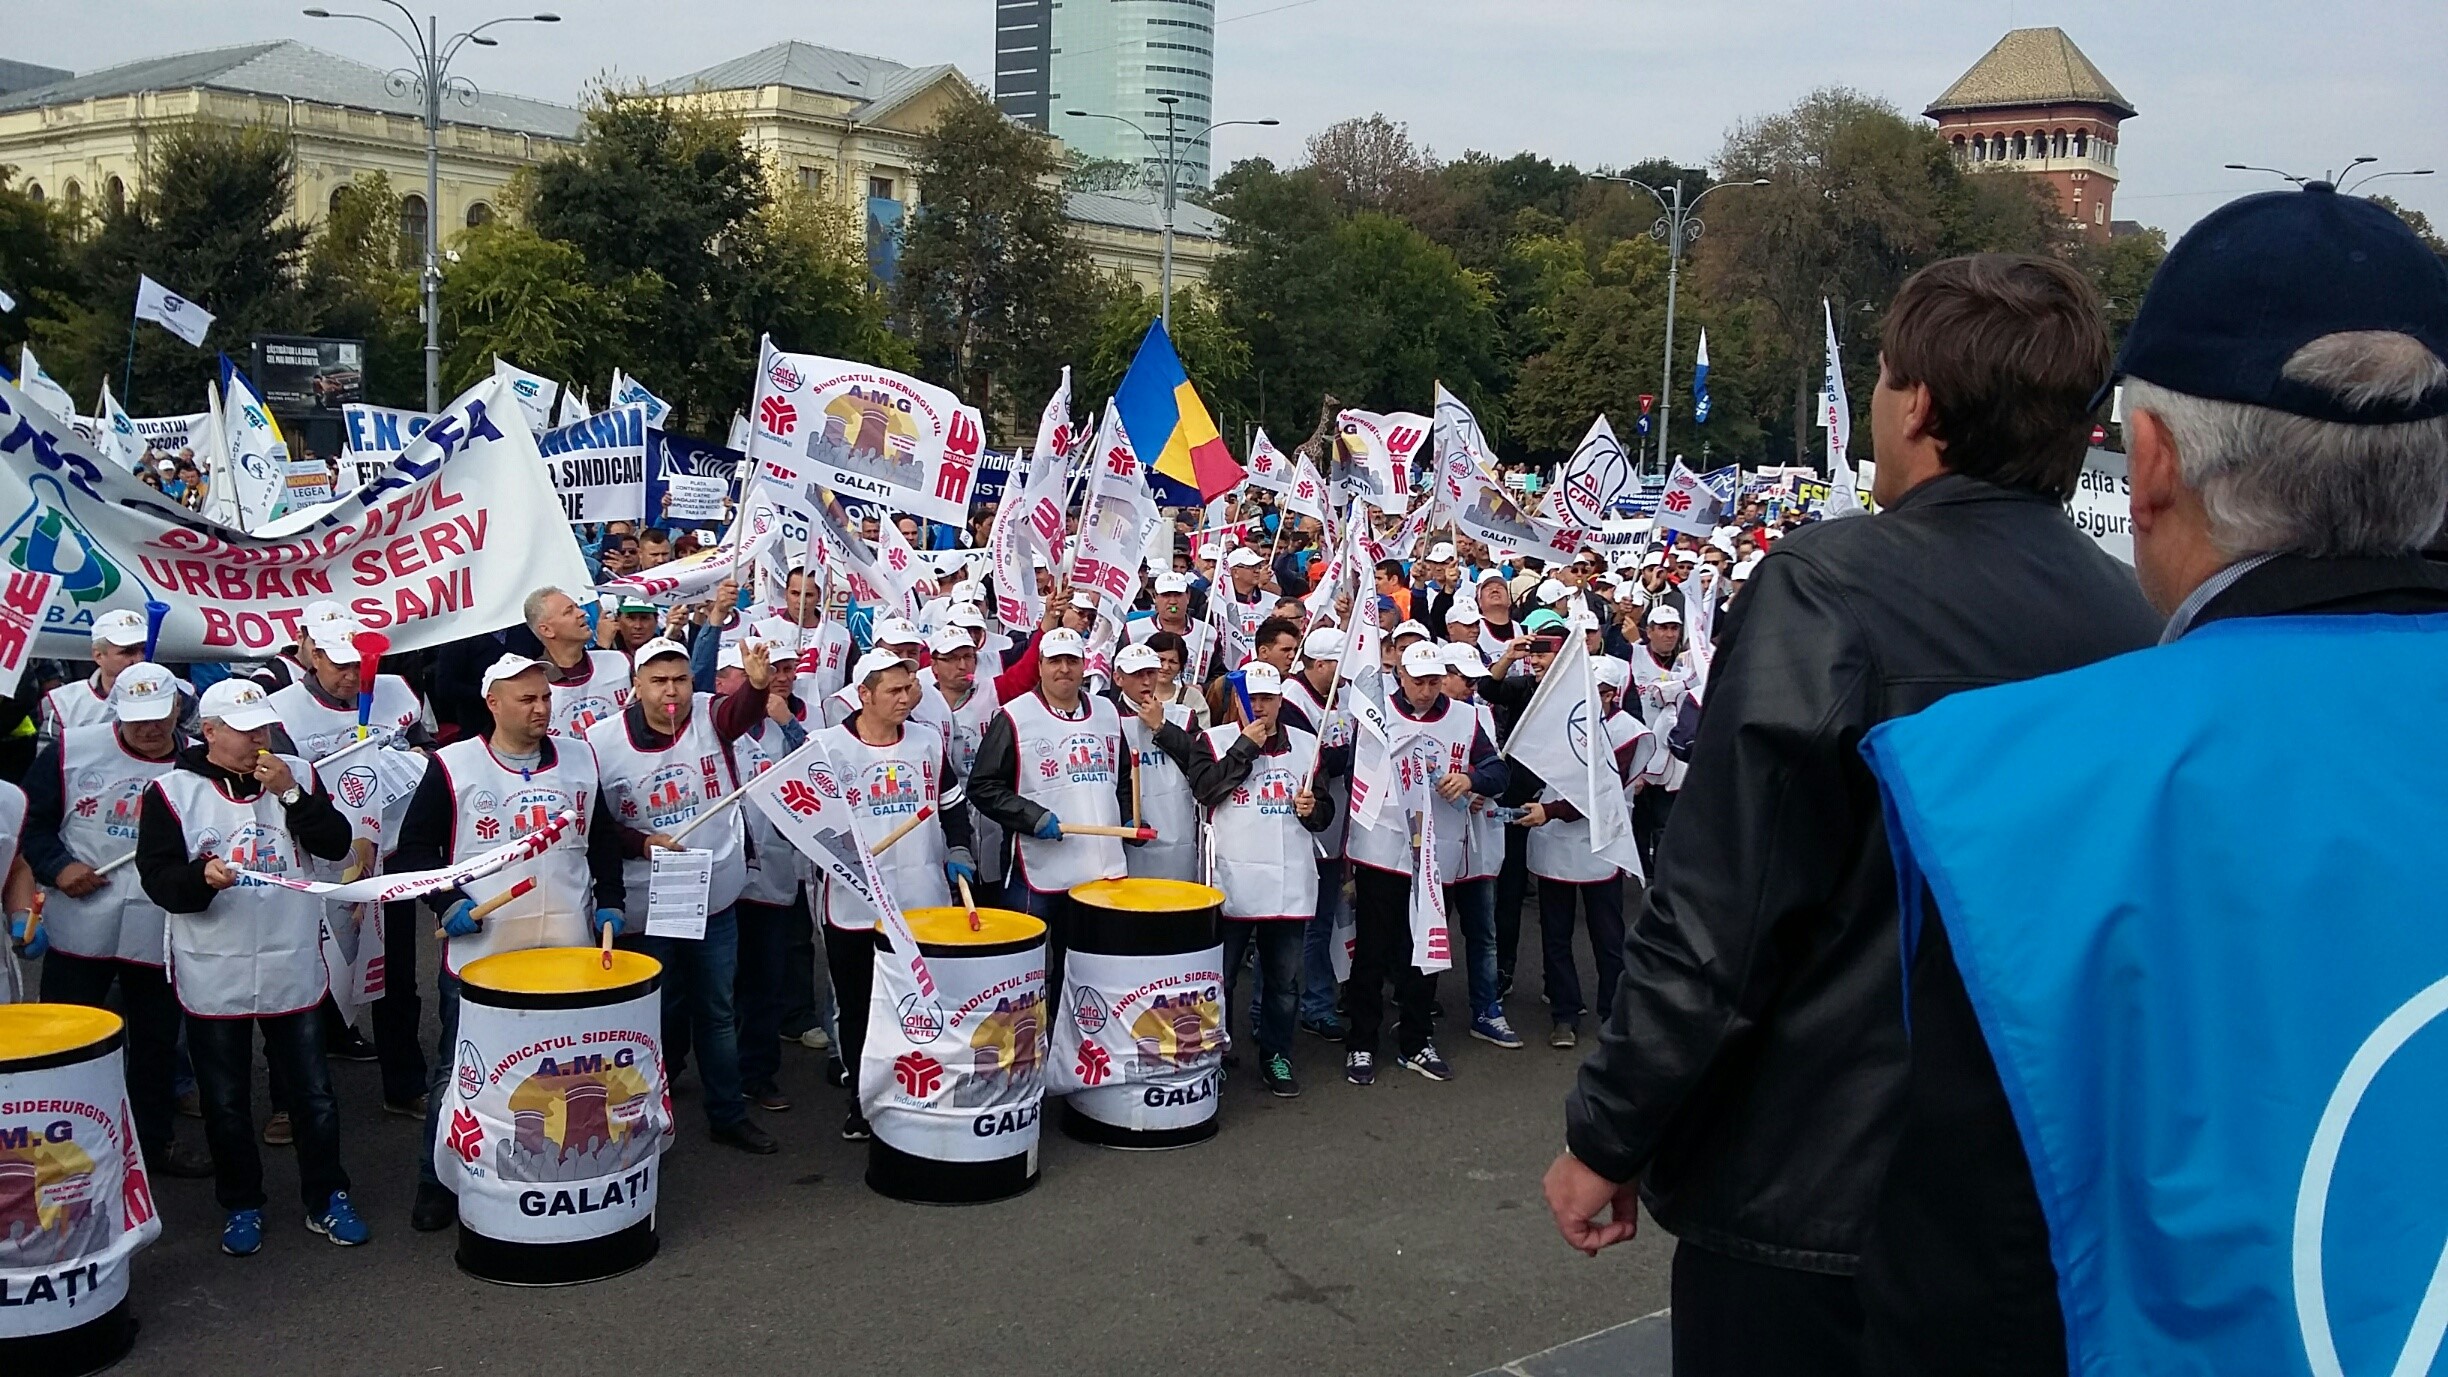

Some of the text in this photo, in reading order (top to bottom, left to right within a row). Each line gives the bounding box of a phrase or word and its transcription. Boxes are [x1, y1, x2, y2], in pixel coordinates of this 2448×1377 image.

[771, 375, 796, 390] CARTEL
[775, 366, 797, 381] alfa
[813, 374, 942, 437] SINDICATUL SIDERURGISTUL
[850, 385, 912, 413] A.M.G
[943, 450, 974, 468] METAROM
[293, 486, 326, 498] LEGEA
[834, 472, 891, 498] GALAȚI
[143, 473, 464, 567] SINDICATUL
[1481, 530, 1517, 547] GALAȚI
[138, 508, 488, 601] URBAN SERV
[1139, 751, 1166, 769] AȚI
[949, 976, 1023, 1028] SINDICATUL
[1112, 975, 1181, 1019] SINDICATUL
[1151, 986, 1217, 1010] A.M.G
[906, 1013, 932, 1028] alfa
[1078, 1018, 1102, 1028] CARTEL
[1080, 1006, 1099, 1018] alfa
[489, 1035, 577, 1085] SINDICATUL
[536, 1048, 635, 1077] A.M.G
[2, 1099, 117, 1150] SIDERURGISTUL
[973, 1102, 1042, 1138] GALA
[519, 1166, 650, 1217] GALAȚI
